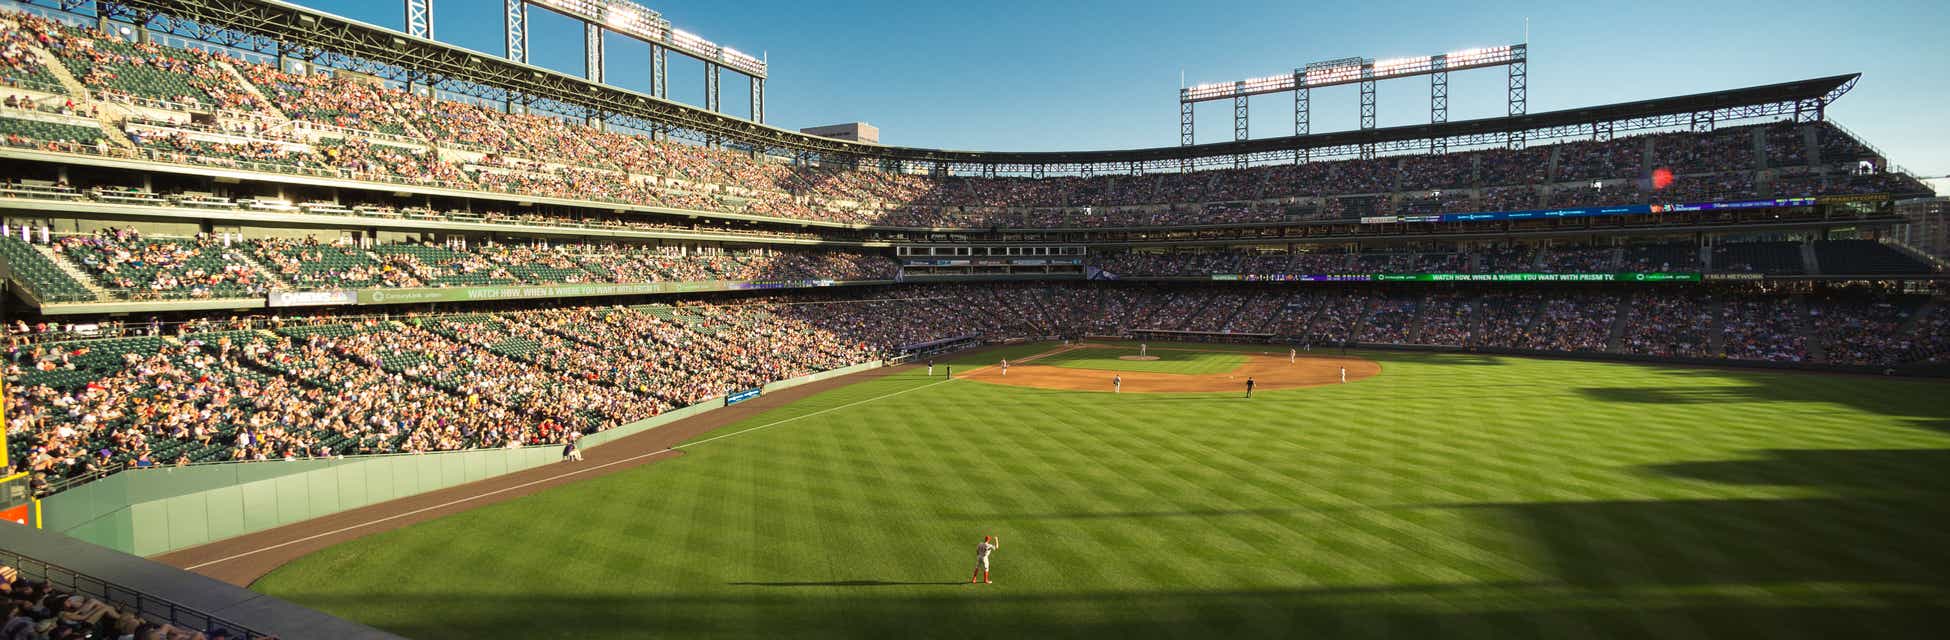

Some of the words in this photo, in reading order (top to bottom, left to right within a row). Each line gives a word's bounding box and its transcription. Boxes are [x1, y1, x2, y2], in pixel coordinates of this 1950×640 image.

[468, 288, 498, 299] WATCH
[523, 287, 545, 297] WHEN
[582, 286, 596, 295] YOU
